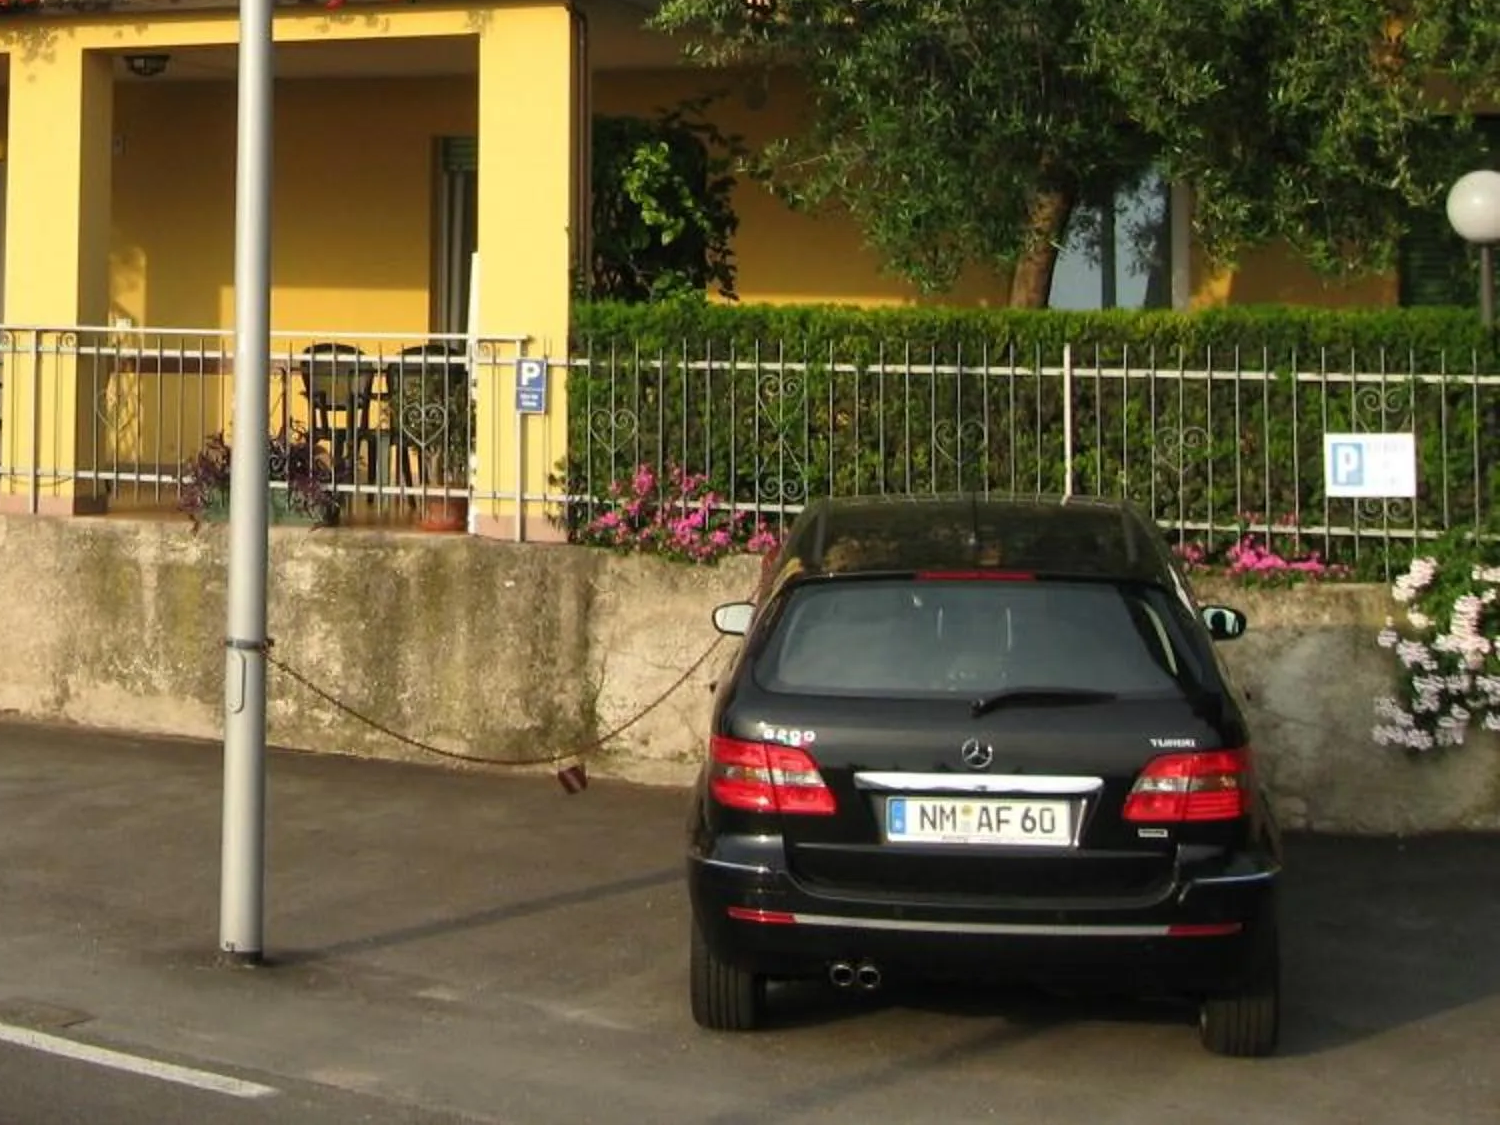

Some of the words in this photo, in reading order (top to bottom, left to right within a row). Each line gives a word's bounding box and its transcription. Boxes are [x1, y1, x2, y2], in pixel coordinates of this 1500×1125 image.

[521, 362, 540, 386] P
[1337, 445, 1359, 484] P
[918, 803, 958, 832] NM
[976, 805, 1013, 833] AF
[1020, 807, 1057, 834] 60
